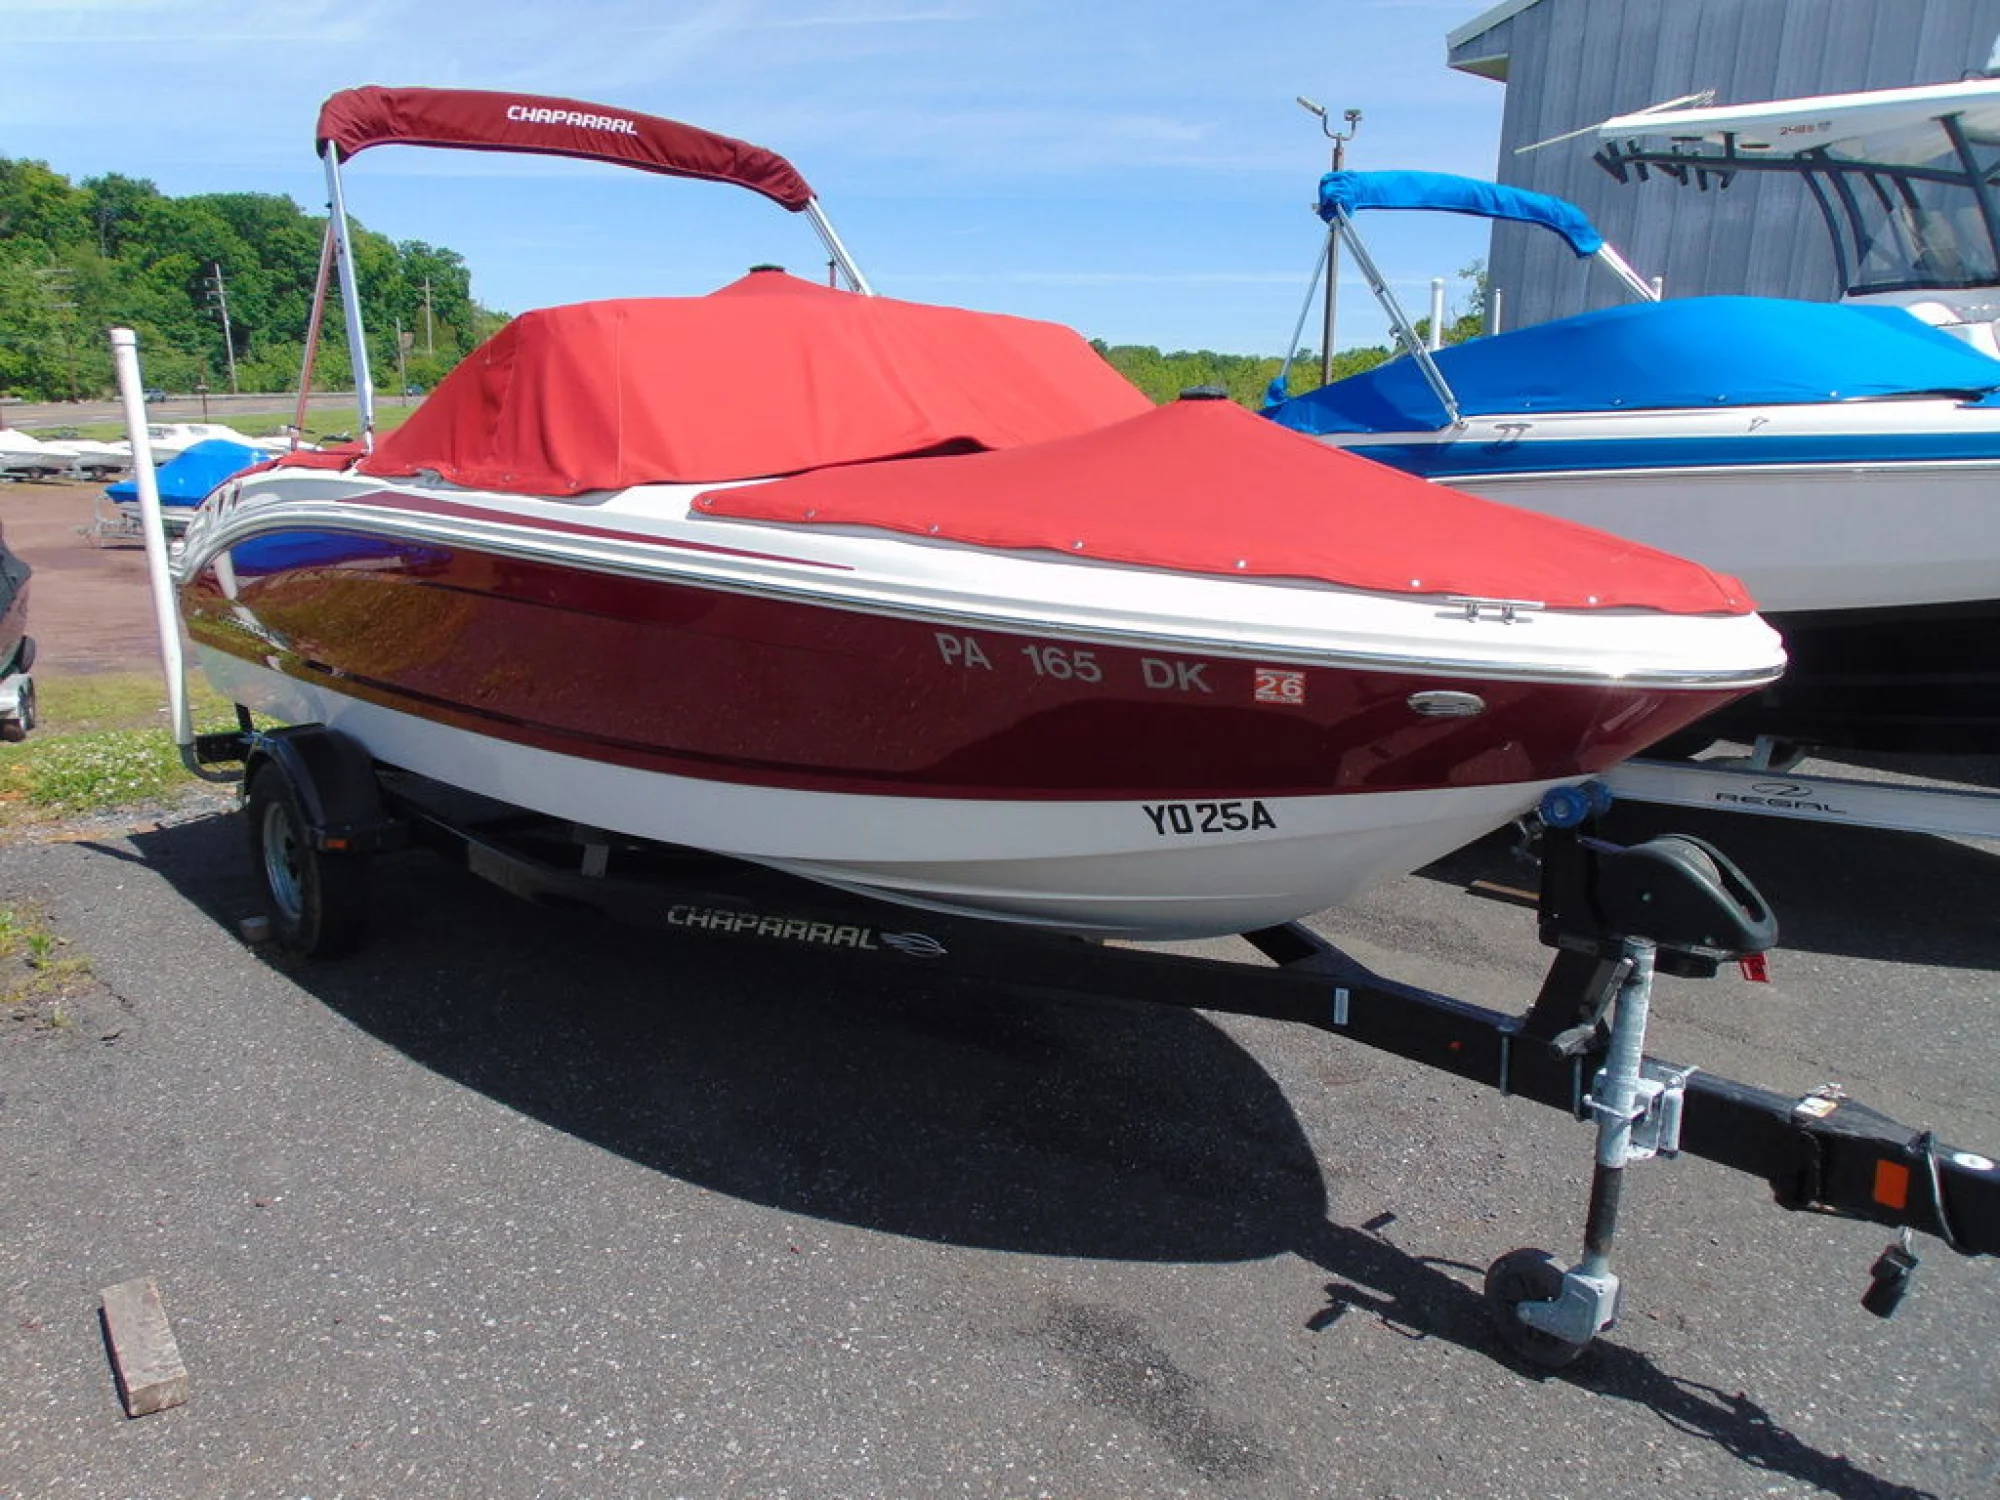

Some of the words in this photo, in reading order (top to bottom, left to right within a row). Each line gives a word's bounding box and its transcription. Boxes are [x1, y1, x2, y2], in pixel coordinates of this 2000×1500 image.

[507, 104, 638, 136] CHAPARRAL
[934, 632, 993, 671] PA
[1022, 643, 1103, 683] 165
[1141, 657, 1213, 693] DK
[1255, 675, 1304, 697] 26
[1716, 792, 1847, 814] REGAL
[667, 903, 878, 950] CHAPARRAL
